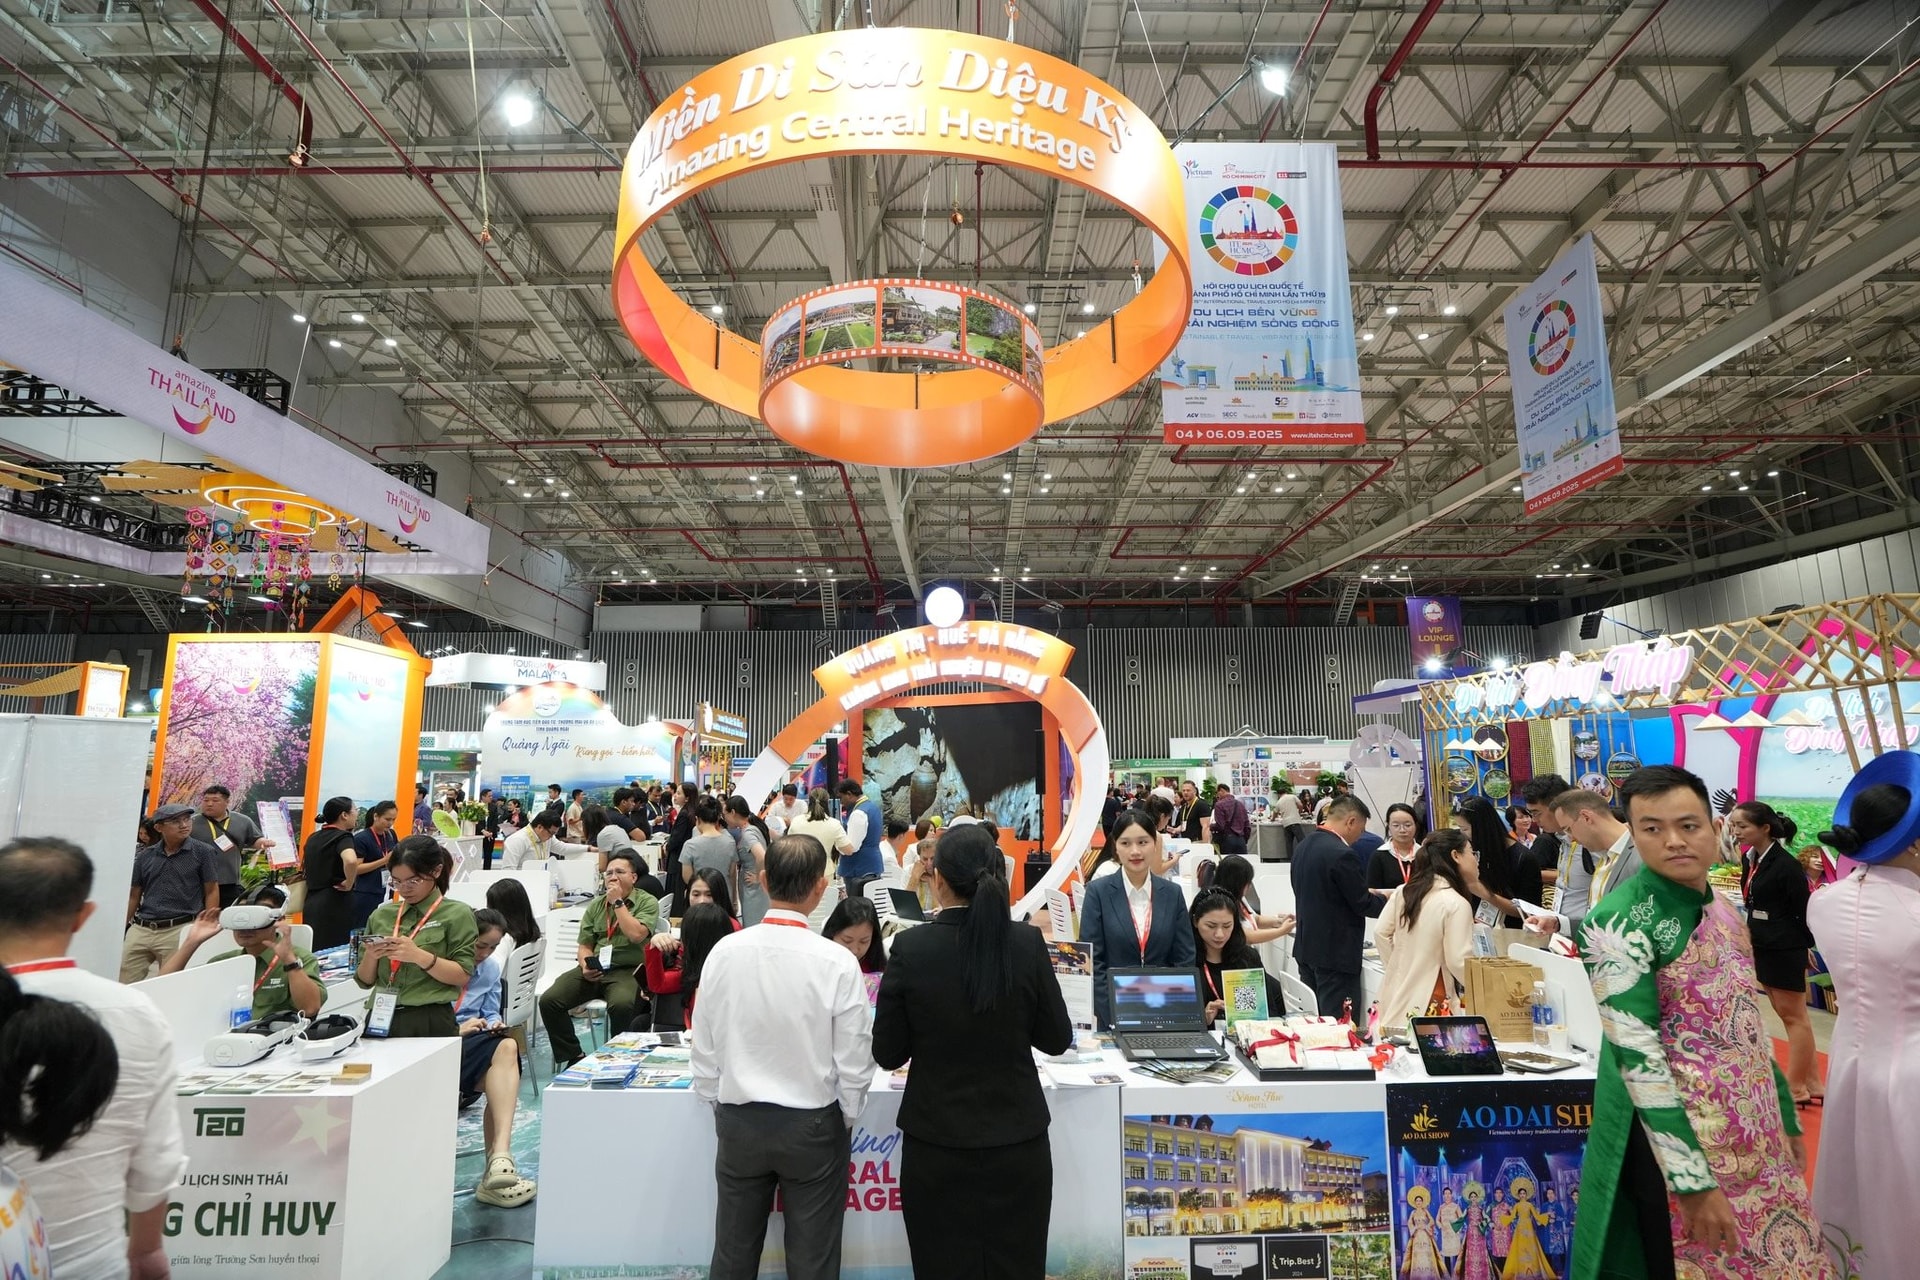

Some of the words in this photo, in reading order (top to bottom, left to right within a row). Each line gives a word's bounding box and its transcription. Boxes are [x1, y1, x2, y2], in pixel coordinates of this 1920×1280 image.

[730, 56, 795, 114] Di
[939, 48, 1068, 116] Diệu
[648, 123, 771, 205] Amazing
[781, 105, 928, 143] Central
[939, 105, 1096, 170] Heritage
[1203, 282, 1217, 290] HỘI
[1269, 281, 1291, 289] QUỐC
[1293, 281, 1304, 289] TẾ
[1216, 309, 1243, 317] LỊCH
[1248, 306, 1275, 316] BỀN
[1280, 308, 1317, 316] VỮNG
[1207, 319, 1257, 329] NGHIỆM
[1261, 318, 1297, 327] SỐNG
[1302, 319, 1339, 328] ĐỘNG
[148, 367, 236, 424] THAILAND
[174, 370, 217, 399] amazing
[1175, 430, 1193, 438] 04
[1206, 430, 1283, 438] 06.09.2025
[1291, 431, 1353, 439] www.itehcmc.travel
[1542, 481, 1579, 504] 06.09.2025
[386, 490, 431, 522] THAILAND
[938, 622, 968, 645] HUẾ
[1455, 682, 1485, 713] Du
[1523, 651, 1602, 709] Đồng
[1603, 637, 1696, 700] Tháp
[502, 736, 540, 757] Quảng
[541, 735, 571, 757] Ngãi
[1784, 721, 1847, 754] Đồng
[193, 1107, 246, 1137] T20
[1457, 1105, 1496, 1129] AO
[1504, 1104, 1552, 1128] DAI
[1556, 1104, 1592, 1127] SH
[1428, 1131, 1450, 1139] SHOW
[1517, 1129, 1533, 1137] history
[189, 1174, 219, 1188] LỊCH
[222, 1174, 253, 1186] SINH
[256, 1171, 288, 1186] THÁI
[194, 1192, 252, 1237] CHỈ
[261, 1202, 336, 1236] HUY
[171, 1254, 190, 1266] giữa
[193, 1254, 212, 1265] lòng
[215, 1254, 247, 1265] Trường
[249, 1253, 266, 1264] Sơn
[268, 1252, 295, 1265] huyền
[297, 1253, 320, 1265] thoại
[1216, 1244, 1237, 1252] agoda
[1279, 1257, 1314, 1267] Trip.Best
